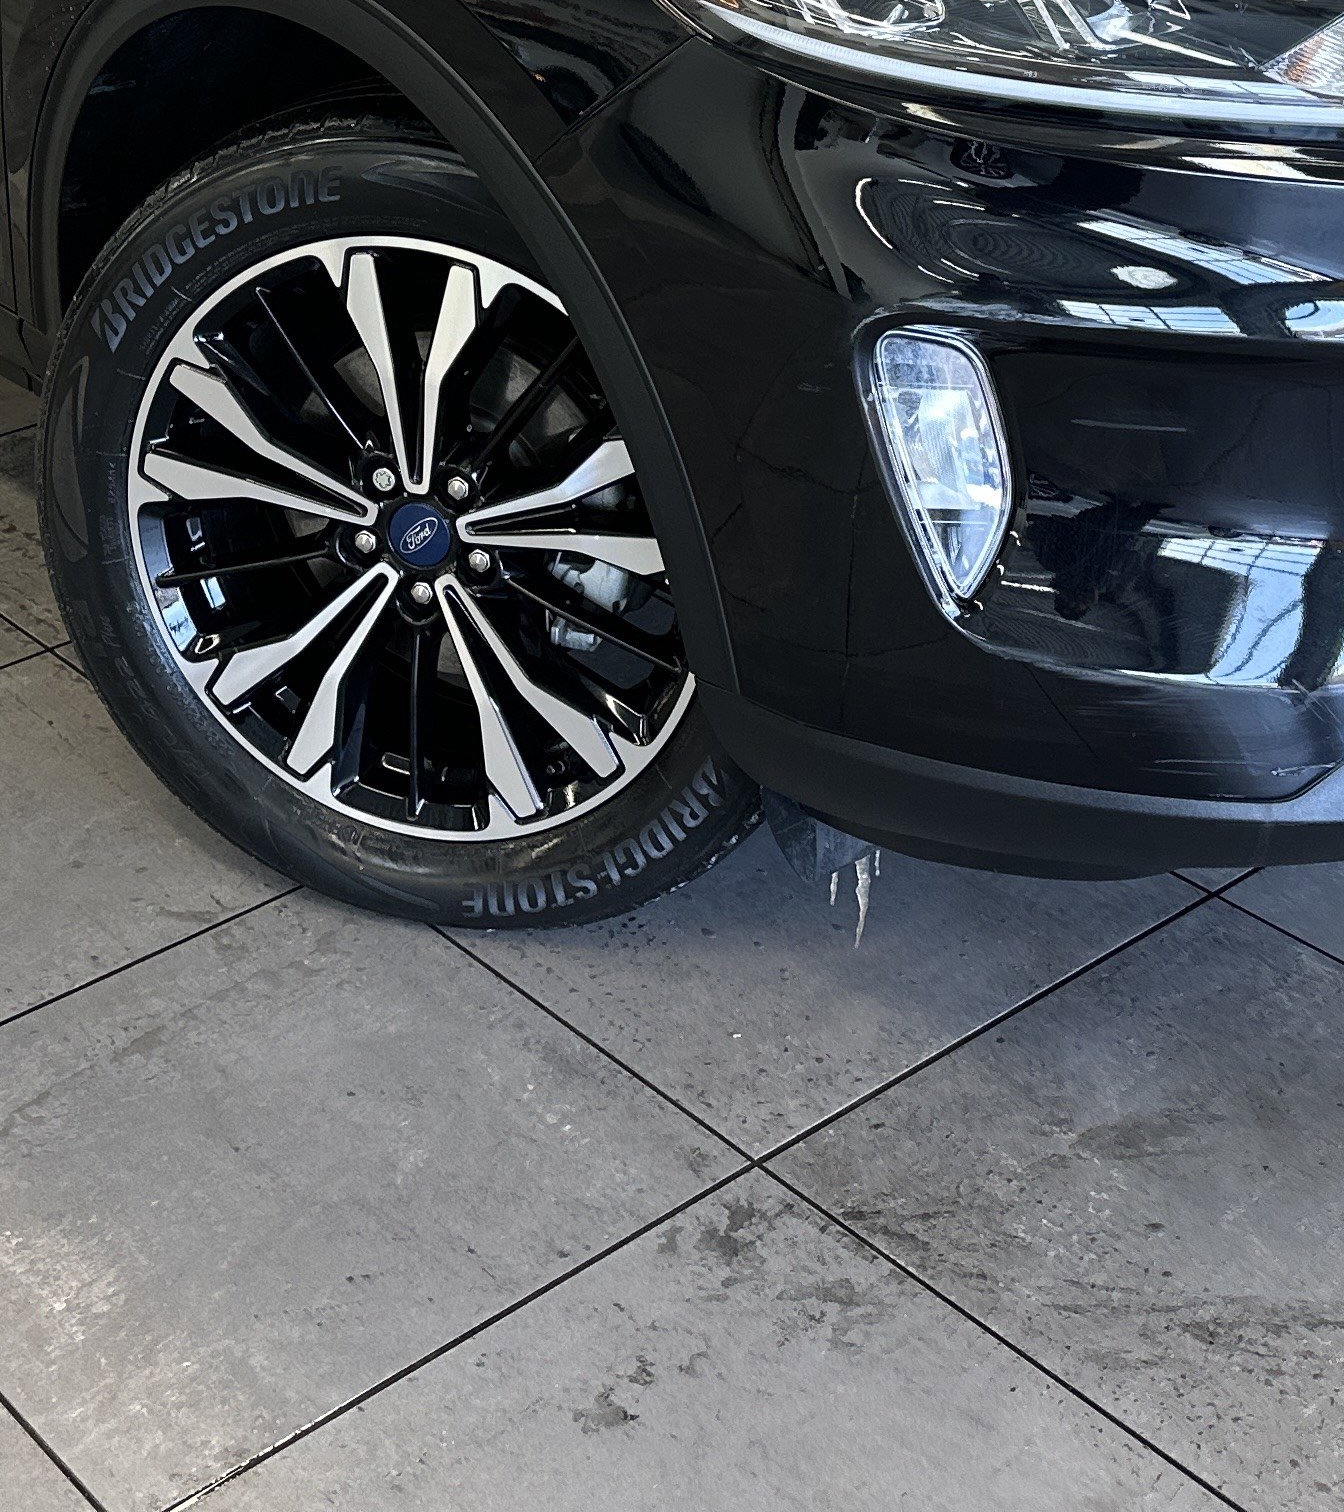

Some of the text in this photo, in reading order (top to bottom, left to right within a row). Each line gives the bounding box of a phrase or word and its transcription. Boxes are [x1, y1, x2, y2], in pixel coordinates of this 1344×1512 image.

[89, 165, 344, 354] BRIDGESTONE
[406, 522, 432, 550] Ford
[461, 753, 732, 920] BRIDGESTONE
